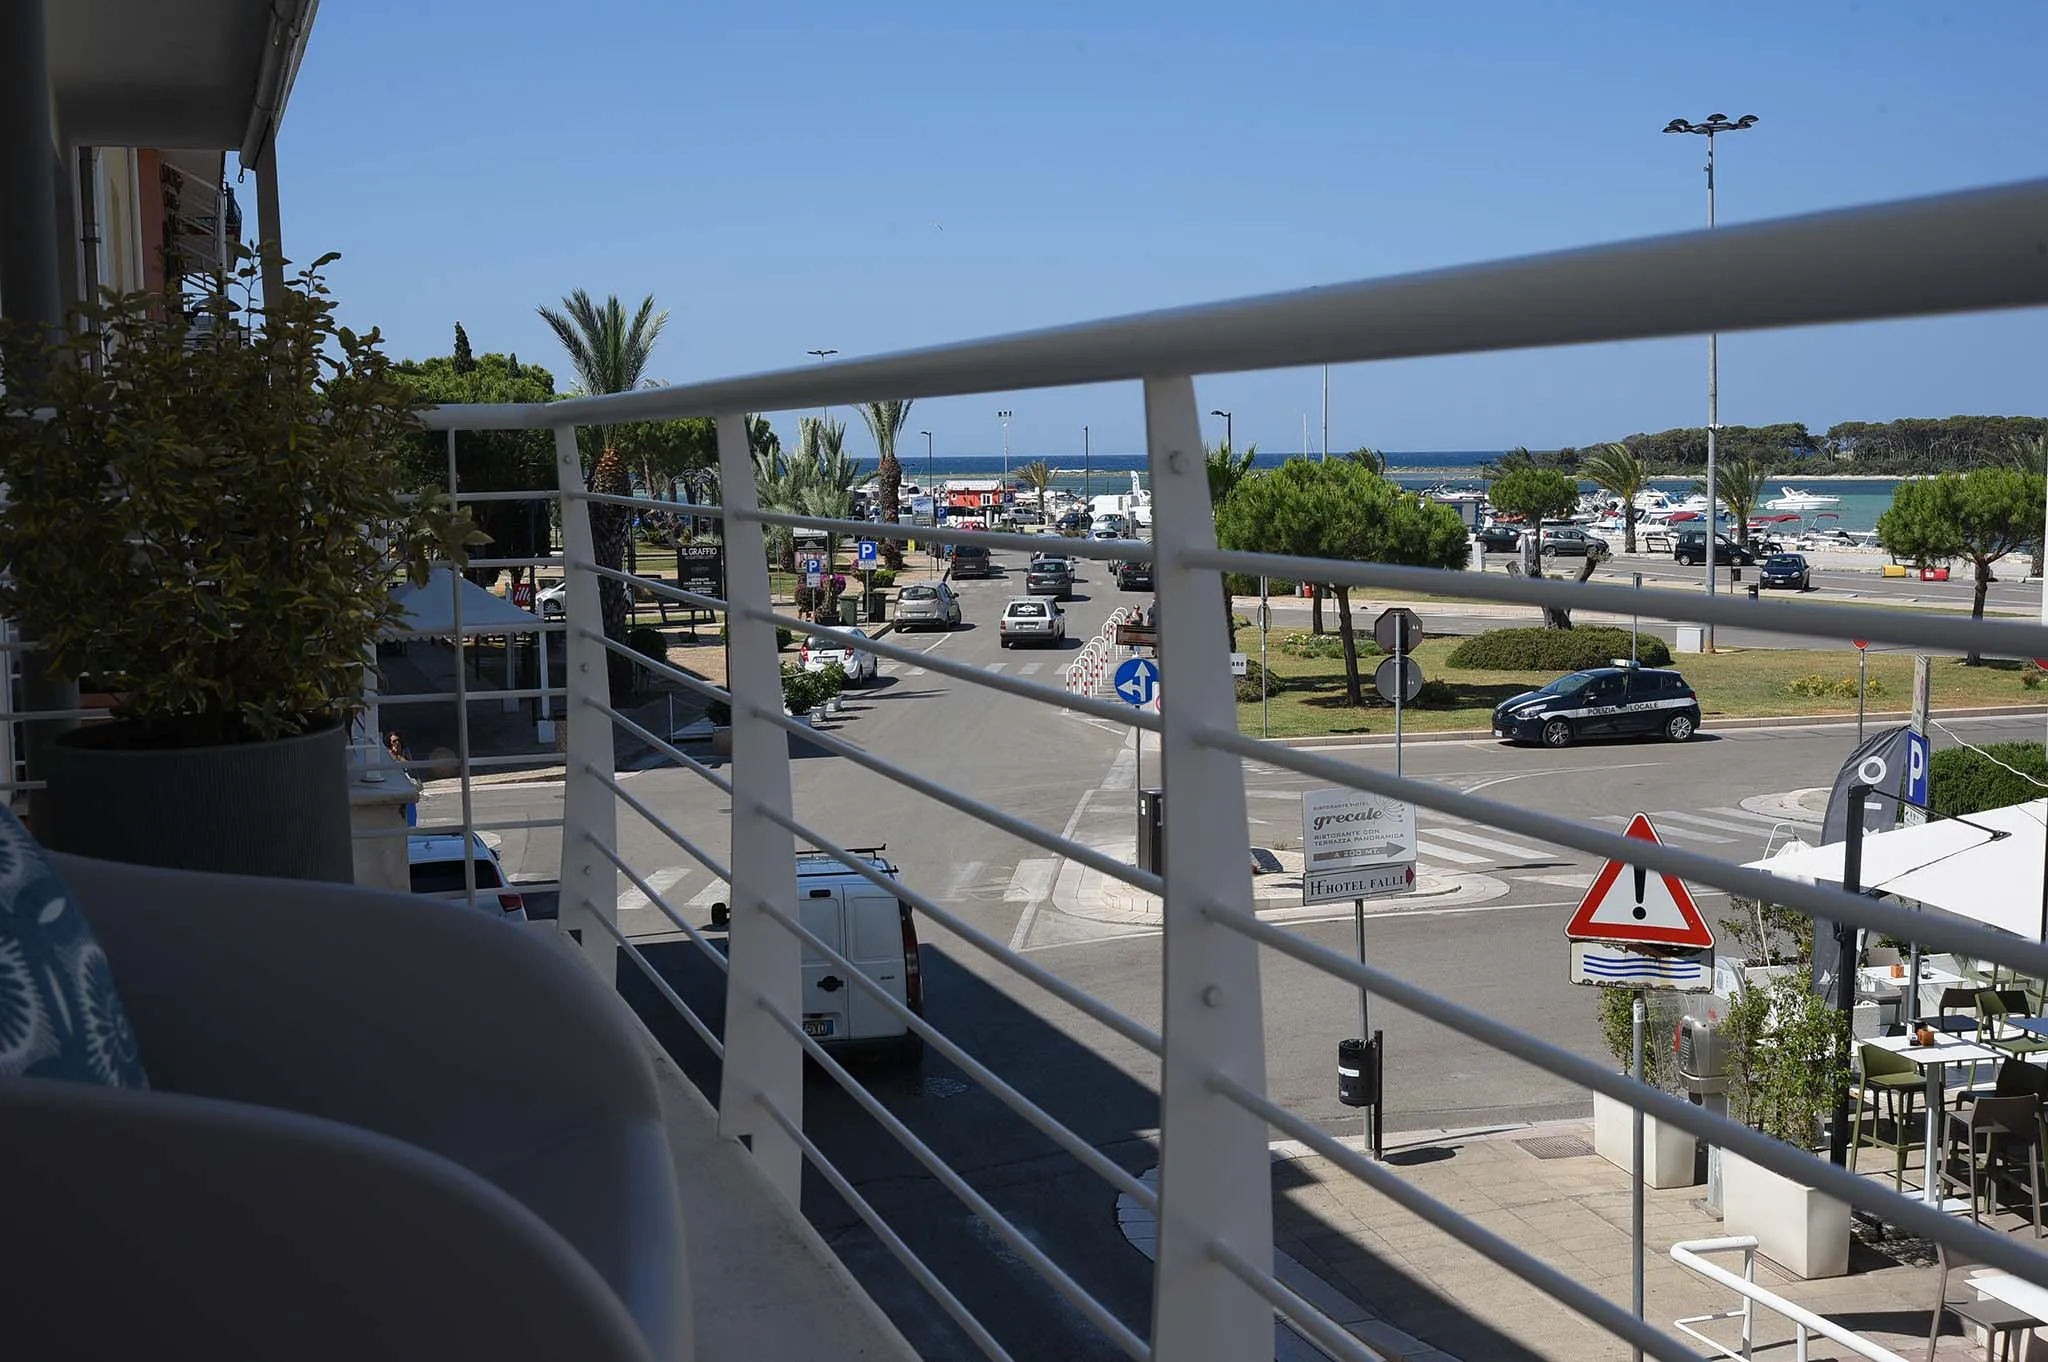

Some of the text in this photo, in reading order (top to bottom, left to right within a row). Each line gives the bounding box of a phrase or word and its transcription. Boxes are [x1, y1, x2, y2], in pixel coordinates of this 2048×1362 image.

[938, 508, 945, 517] P
[688, 547, 718, 556] GRAFFIO
[861, 544, 873, 559] P
[808, 560, 818, 572] P
[1587, 702, 1659, 715] POLIZIA LOCALE
[1909, 739, 1923, 797] P
[1313, 807, 1384, 831] grecale
[1314, 830, 1361, 841] RISTORANTE
[1314, 832, 1405, 847] TERRAZZA PANORAMICA
[1343, 849, 1362, 857] 200
[1326, 880, 1367, 894] HOTEL
[1370, 875, 1403, 889] FALLI
